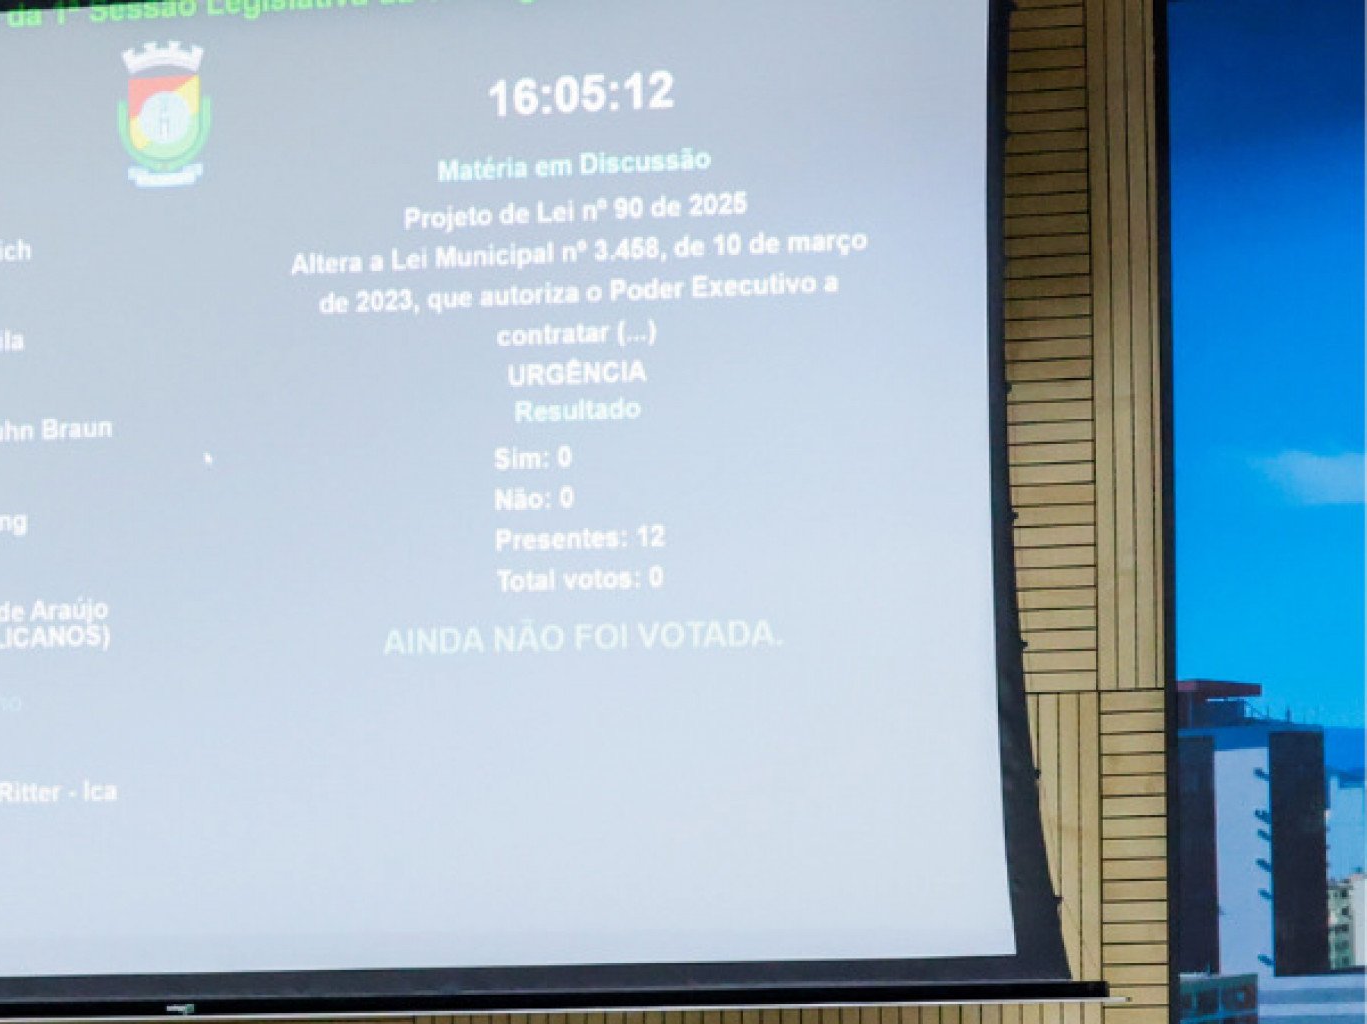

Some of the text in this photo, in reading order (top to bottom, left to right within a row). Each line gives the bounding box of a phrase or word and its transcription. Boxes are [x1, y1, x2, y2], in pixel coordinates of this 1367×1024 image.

[8, 3, 42, 28] da
[488, 70, 676, 119] 16:05:12
[437, 149, 713, 182] Matéria em Discussão
[405, 205, 492, 234] Projeto
[499, 203, 529, 226] de
[538, 201, 574, 224] Lei
[614, 198, 644, 221] 90
[652, 196, 681, 219] de
[689, 191, 748, 217] 2025
[291, 252, 363, 276] Altera
[370, 255, 384, 272] a
[392, 247, 427, 271] Lei
[435, 242, 555, 272] Municipal
[675, 235, 705, 259] de
[713, 233, 741, 256] 10
[749, 232, 779, 255] de
[788, 234, 869, 259] março
[319, 271, 840, 315] de 2023, que autoriza o Poder Executivo a
[497, 319, 657, 348] contratar (...)
[508, 357, 649, 387] URGÊNCIA
[514, 397, 642, 423] Resultado
[41, 418, 114, 441] Braun
[494, 445, 574, 472] Sim: 0
[495, 484, 576, 511] Não: 0
[495, 522, 666, 552] Presentes: 12
[497, 566, 665, 593] Total votos: 0
[30, 595, 110, 627] Araújo
[383, 616, 783, 657] AINDA NÃO FOI VOTADA.
